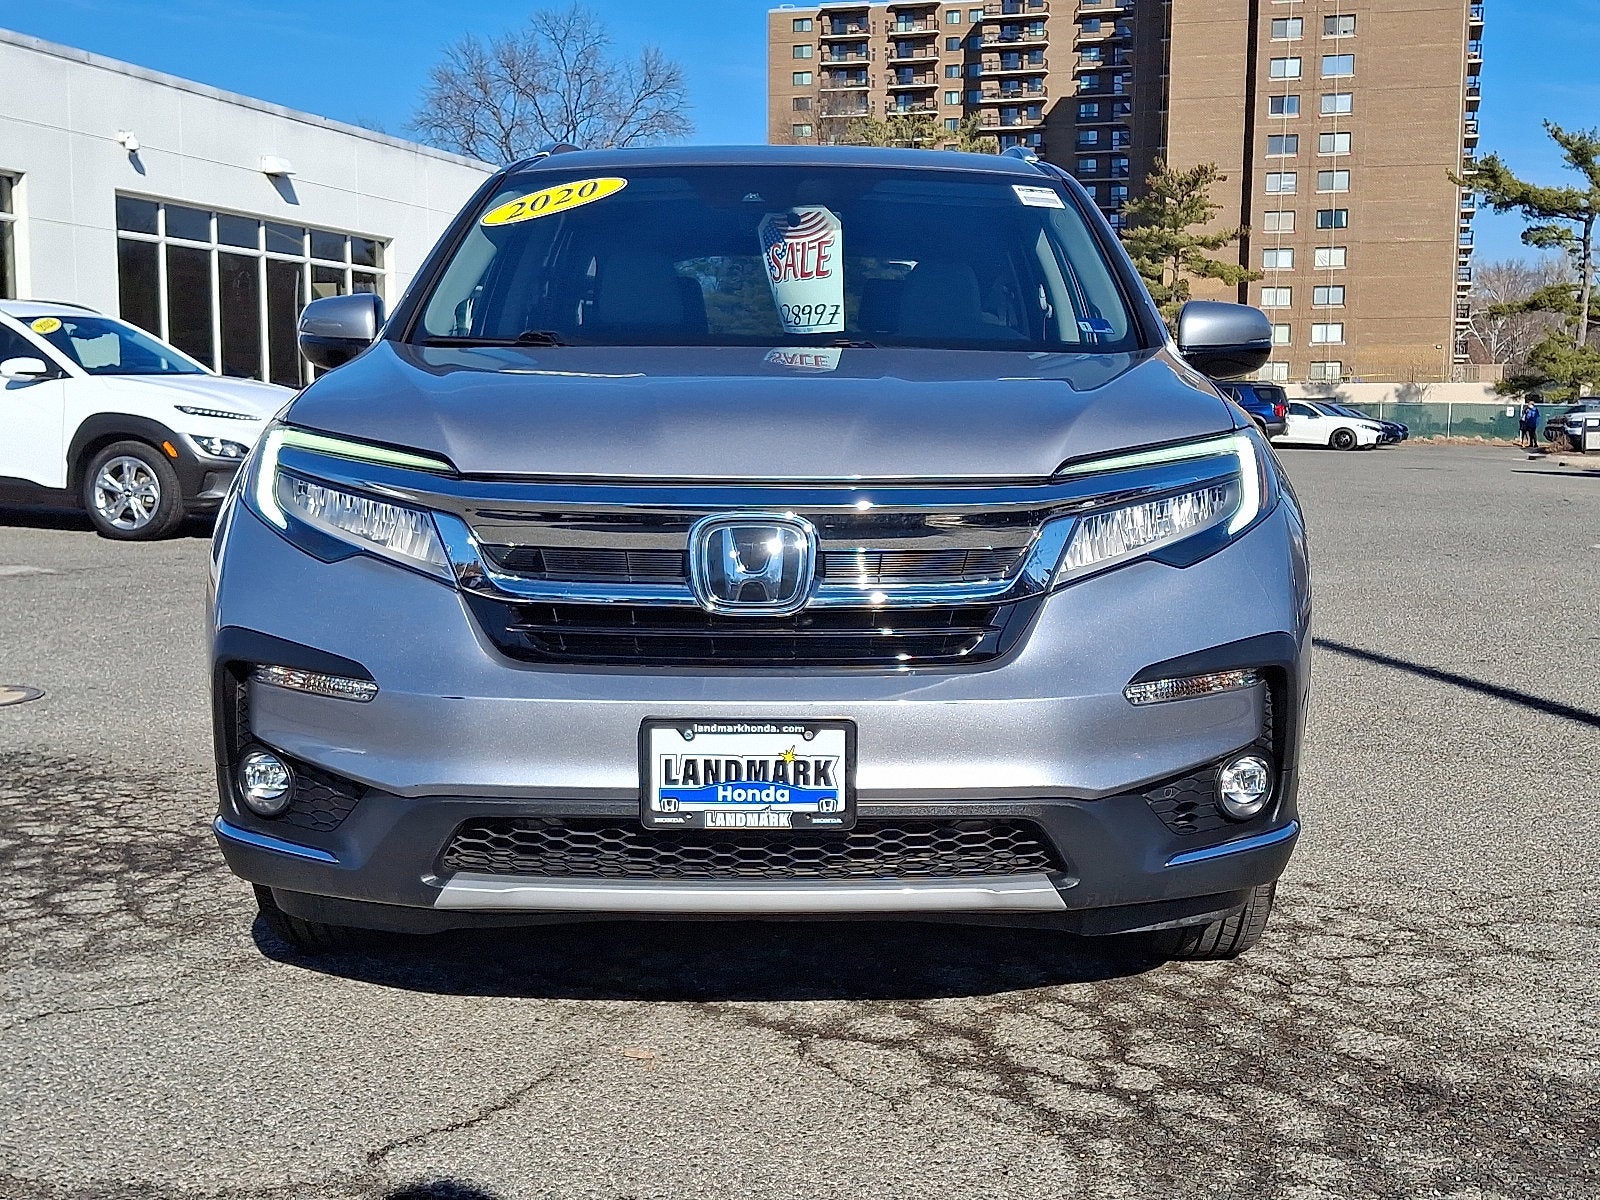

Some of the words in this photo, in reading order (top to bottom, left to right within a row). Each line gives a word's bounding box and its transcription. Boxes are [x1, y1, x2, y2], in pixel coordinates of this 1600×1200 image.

[505, 181, 599, 221] 2020
[770, 239, 835, 283] SALE
[780, 303, 841, 326] 28997
[664, 758, 833, 787] LANDMARK
[717, 786, 791, 803] Honda
[705, 809, 792, 828] LANDMARK
